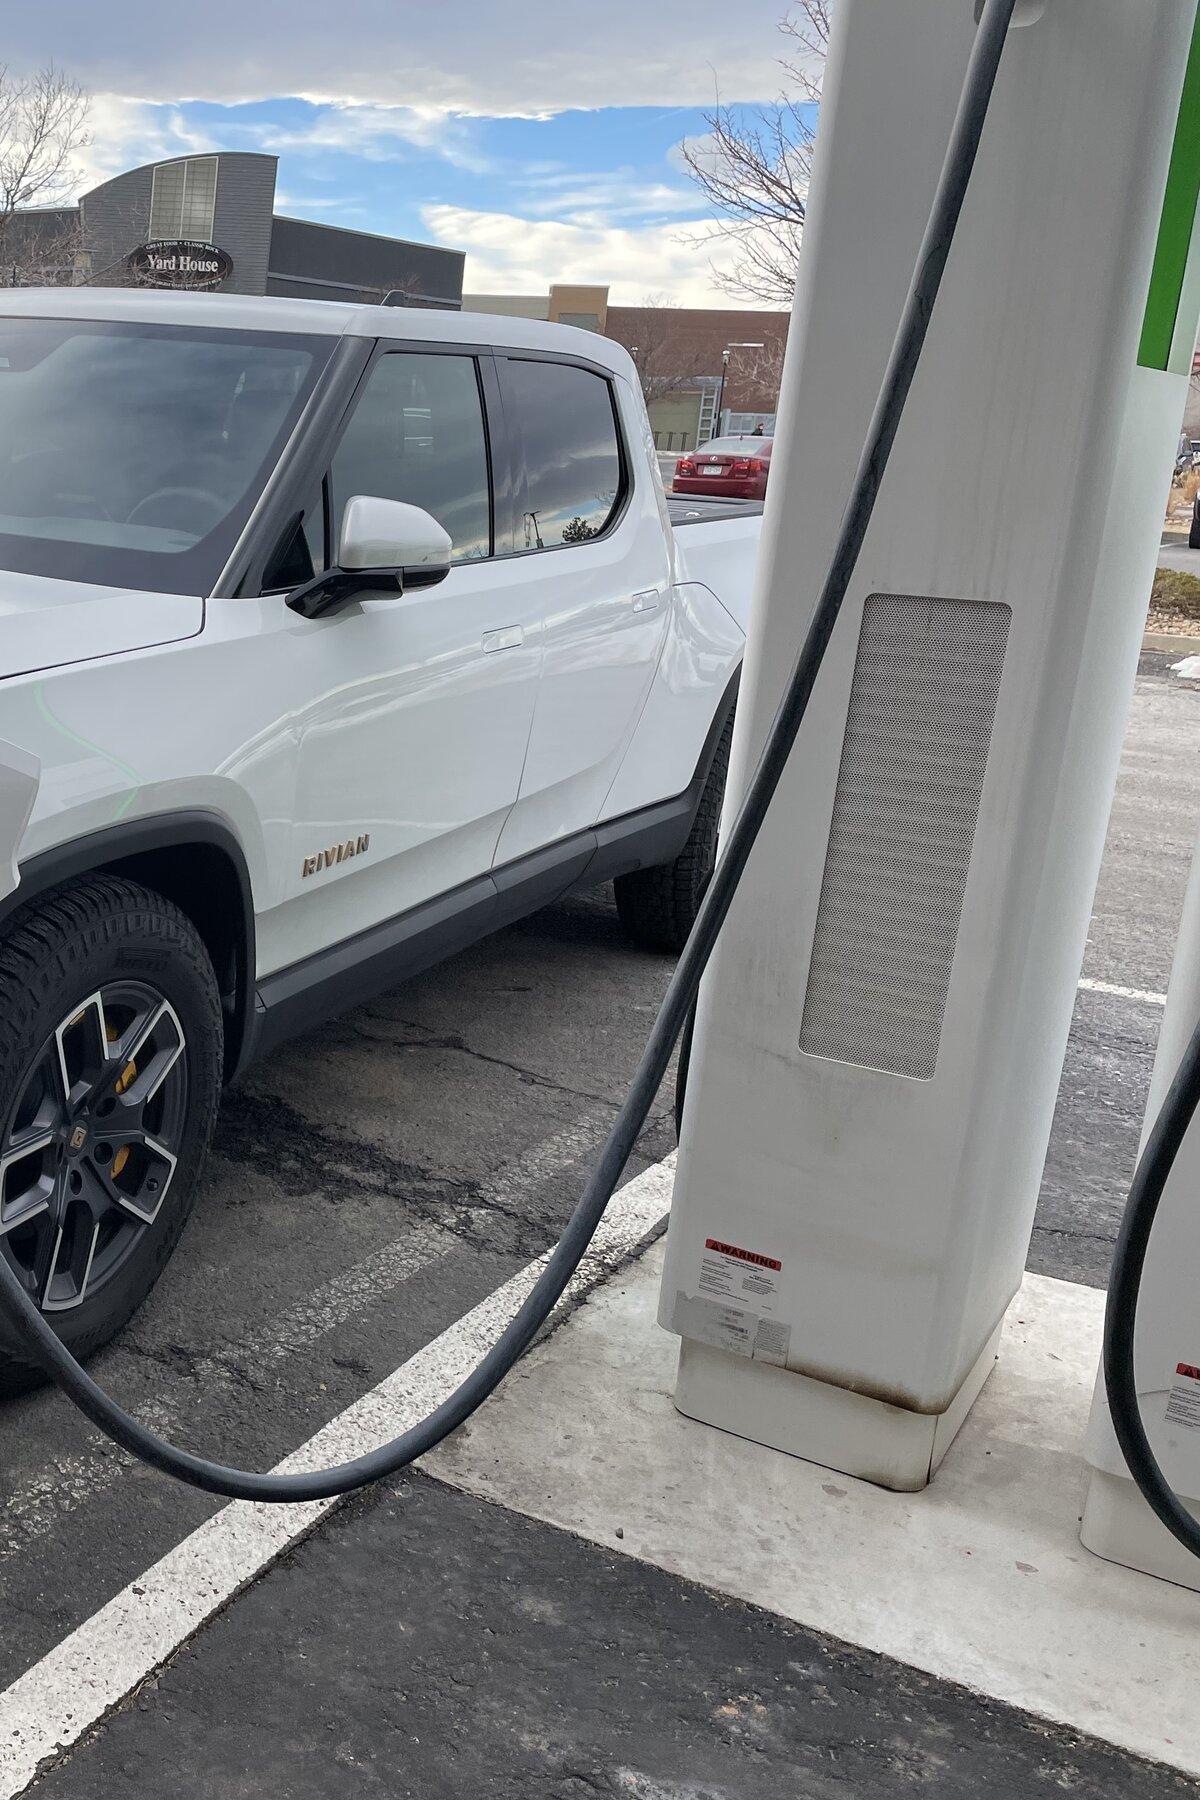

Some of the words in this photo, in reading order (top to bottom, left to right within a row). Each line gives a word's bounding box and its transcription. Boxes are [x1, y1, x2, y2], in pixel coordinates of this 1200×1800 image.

[147, 254, 176, 271] Yard
[179, 255, 219, 272] House
[302, 833, 370, 878] RIVIAN
[720, 1242, 777, 1269] WARNING
